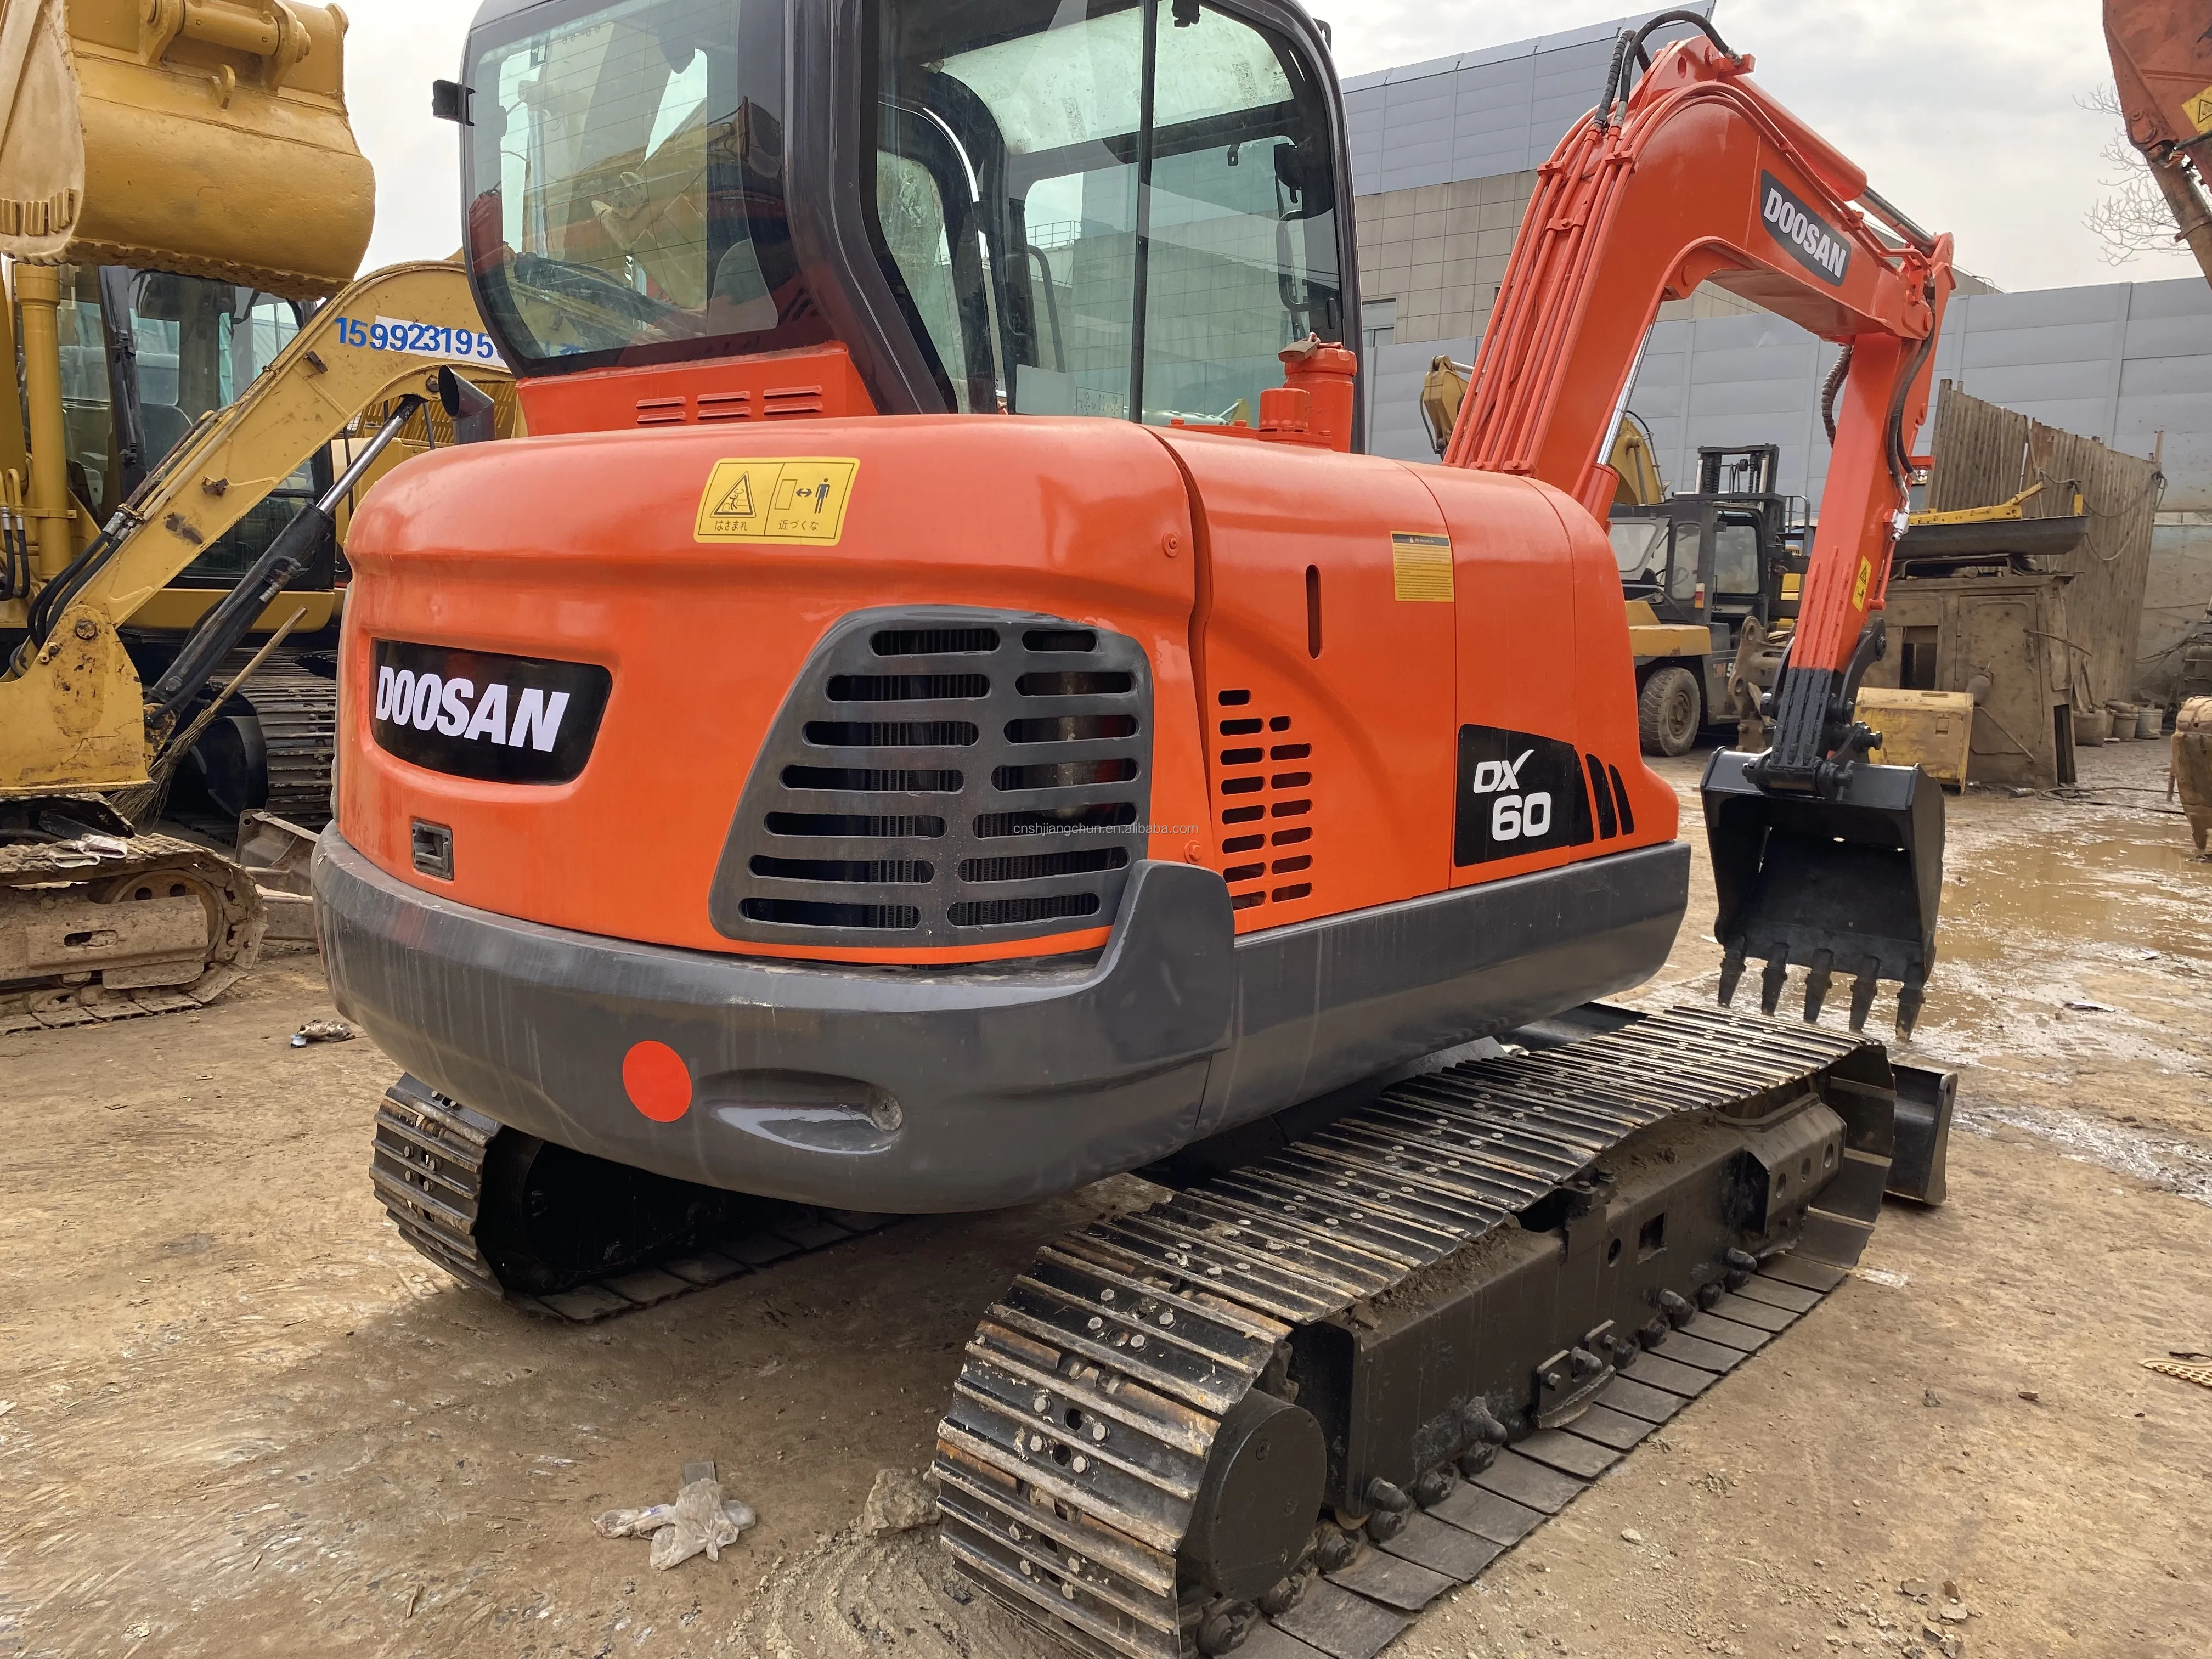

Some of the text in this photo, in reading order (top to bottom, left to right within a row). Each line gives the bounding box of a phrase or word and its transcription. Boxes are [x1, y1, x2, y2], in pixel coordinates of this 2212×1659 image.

[1763, 188, 1847, 278] DOOSAN
[335, 317, 504, 360] 159923195
[714, 520, 748, 531] はさまれ
[778, 520, 819, 531] 近づくな
[375, 665, 571, 753] DOOSAN
[1473, 749, 1534, 793] DX
[1492, 792, 1551, 842] 60
